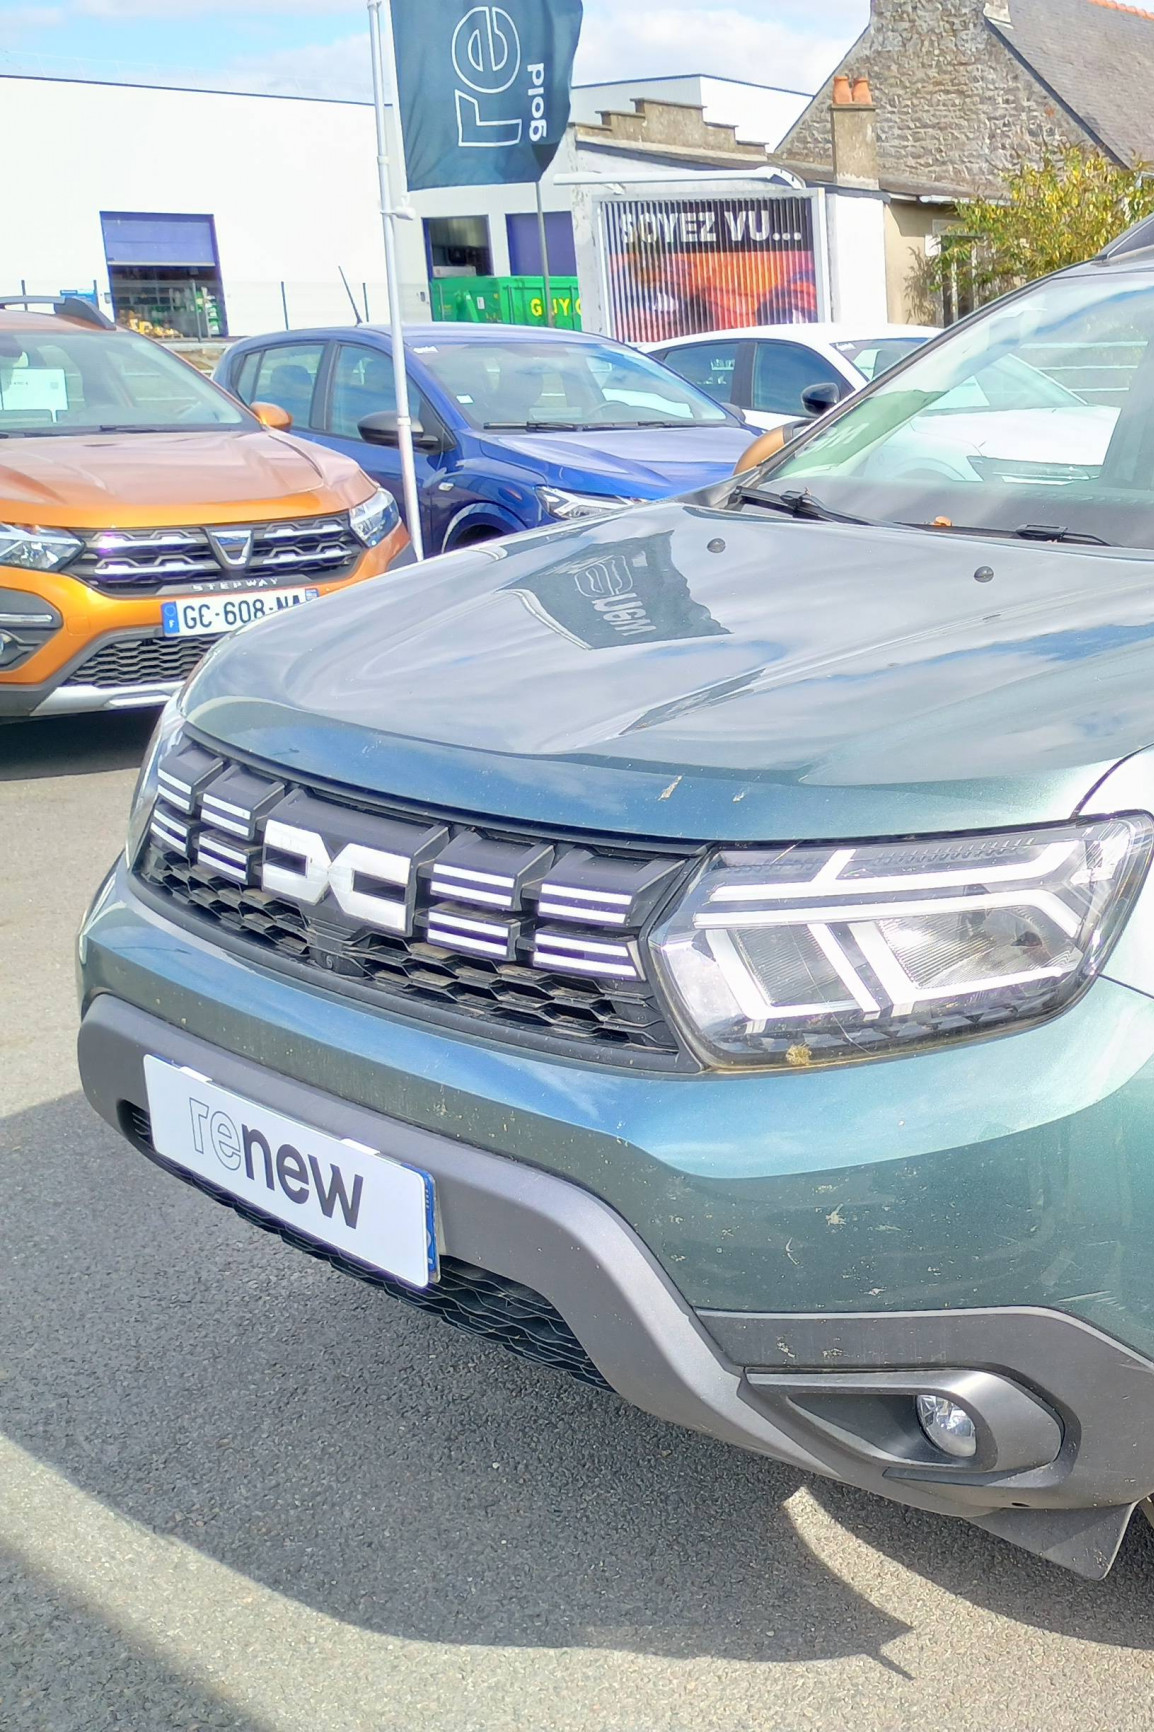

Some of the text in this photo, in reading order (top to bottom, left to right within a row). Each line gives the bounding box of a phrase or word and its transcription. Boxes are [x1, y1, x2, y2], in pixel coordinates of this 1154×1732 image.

[451, 6, 522, 147] re
[527, 62, 547, 142] gold
[620, 209, 802, 243] SOYEZ VU...
[192, 578, 278, 592] STEPWAY
[189, 1096, 364, 1230] renew
